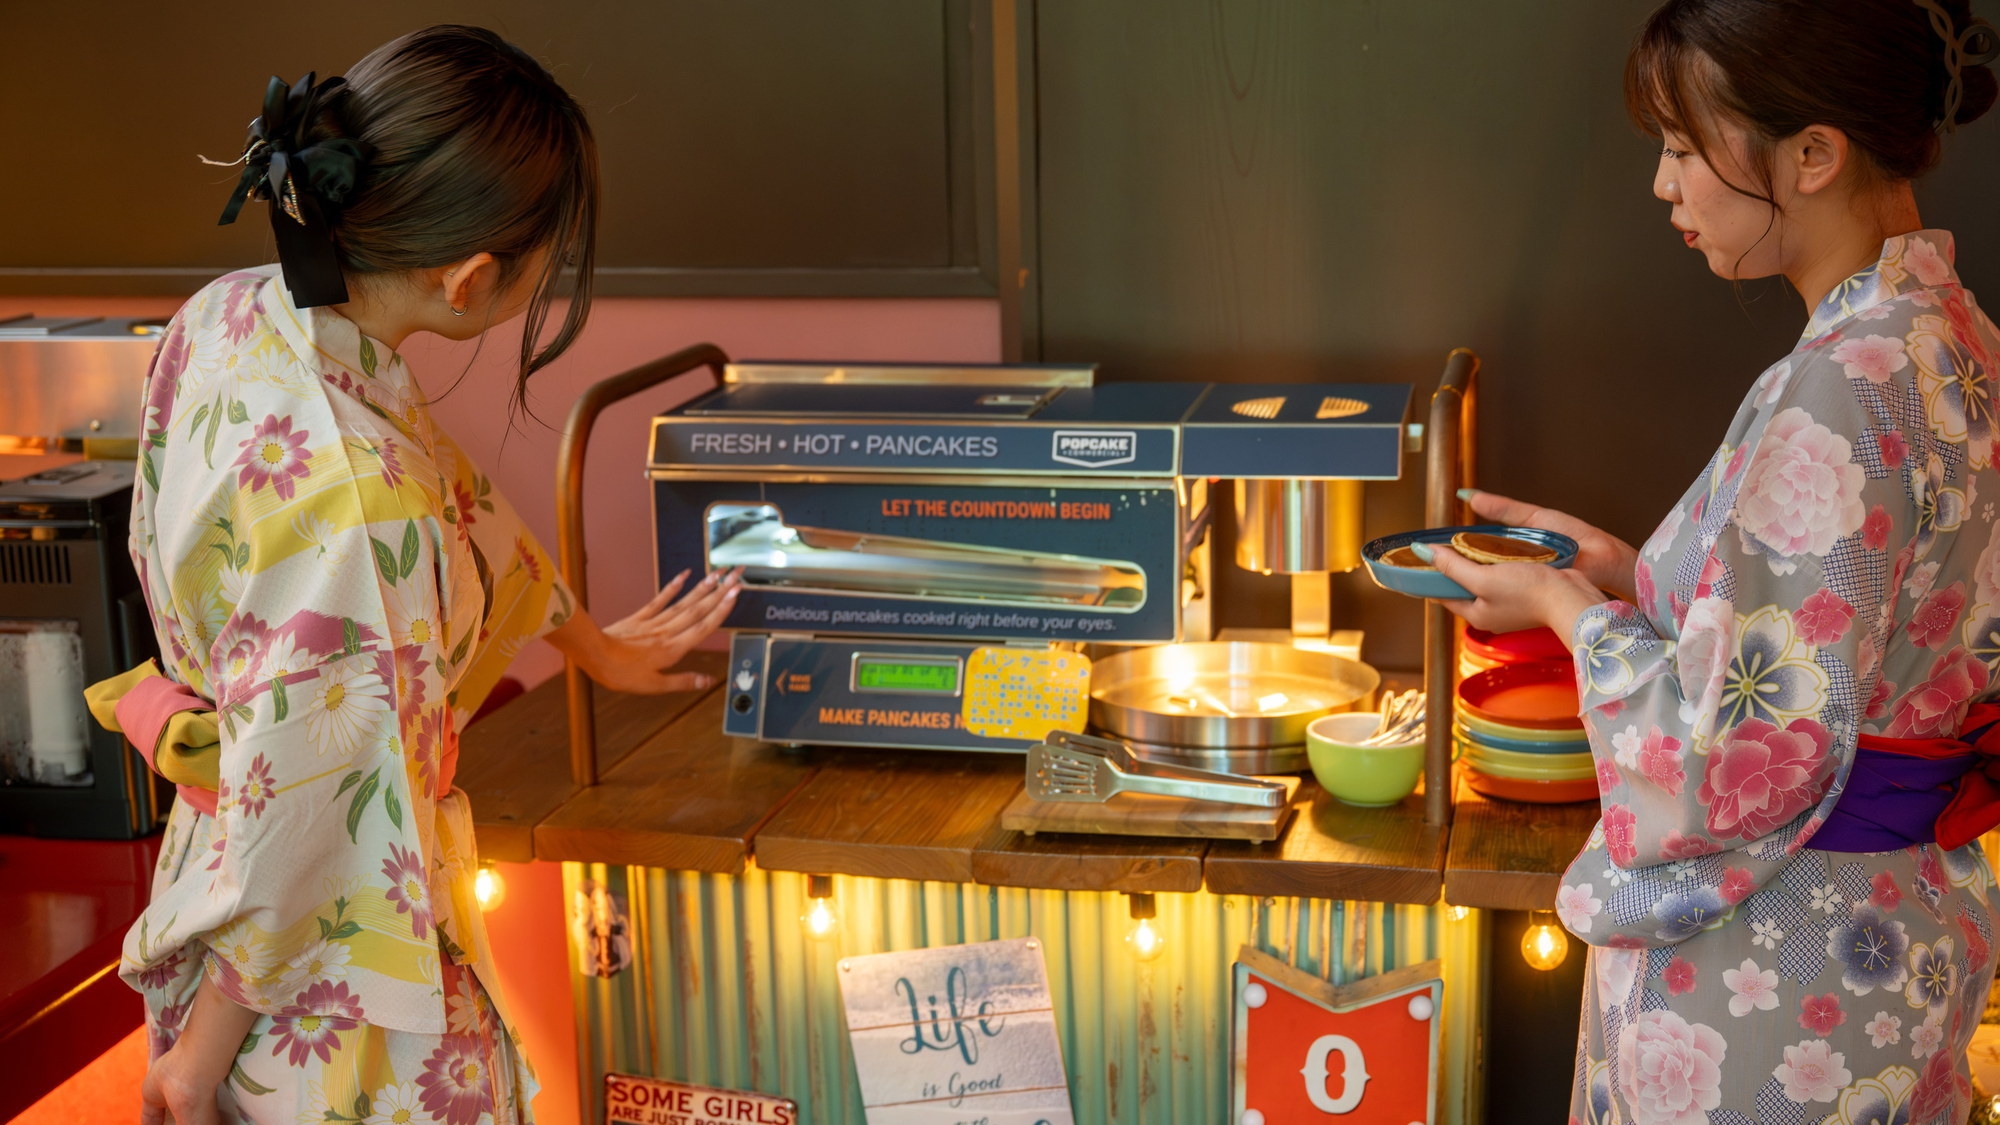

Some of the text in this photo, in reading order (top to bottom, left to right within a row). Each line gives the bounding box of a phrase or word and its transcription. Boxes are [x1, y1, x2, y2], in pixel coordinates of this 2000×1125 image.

[690, 433, 999, 457] FRESH HOT PANCAKES
[1060, 438, 1129, 451] POPCAKE
[881, 499, 1111, 520] LET THE COUNTDOWN BEGIN
[765, 605, 1117, 634] Delicious pancakes cooked right before your eyes.
[819, 707, 865, 726] MAKE
[867, 709, 950, 729] PANCAKES
[895, 966, 1006, 1065] Life
[922, 1072, 1003, 1108] is Good
[611, 1081, 791, 1125] SOME GIRLS
[612, 1105, 643, 1121] ARE
[648, 1111, 688, 1125] JUST
